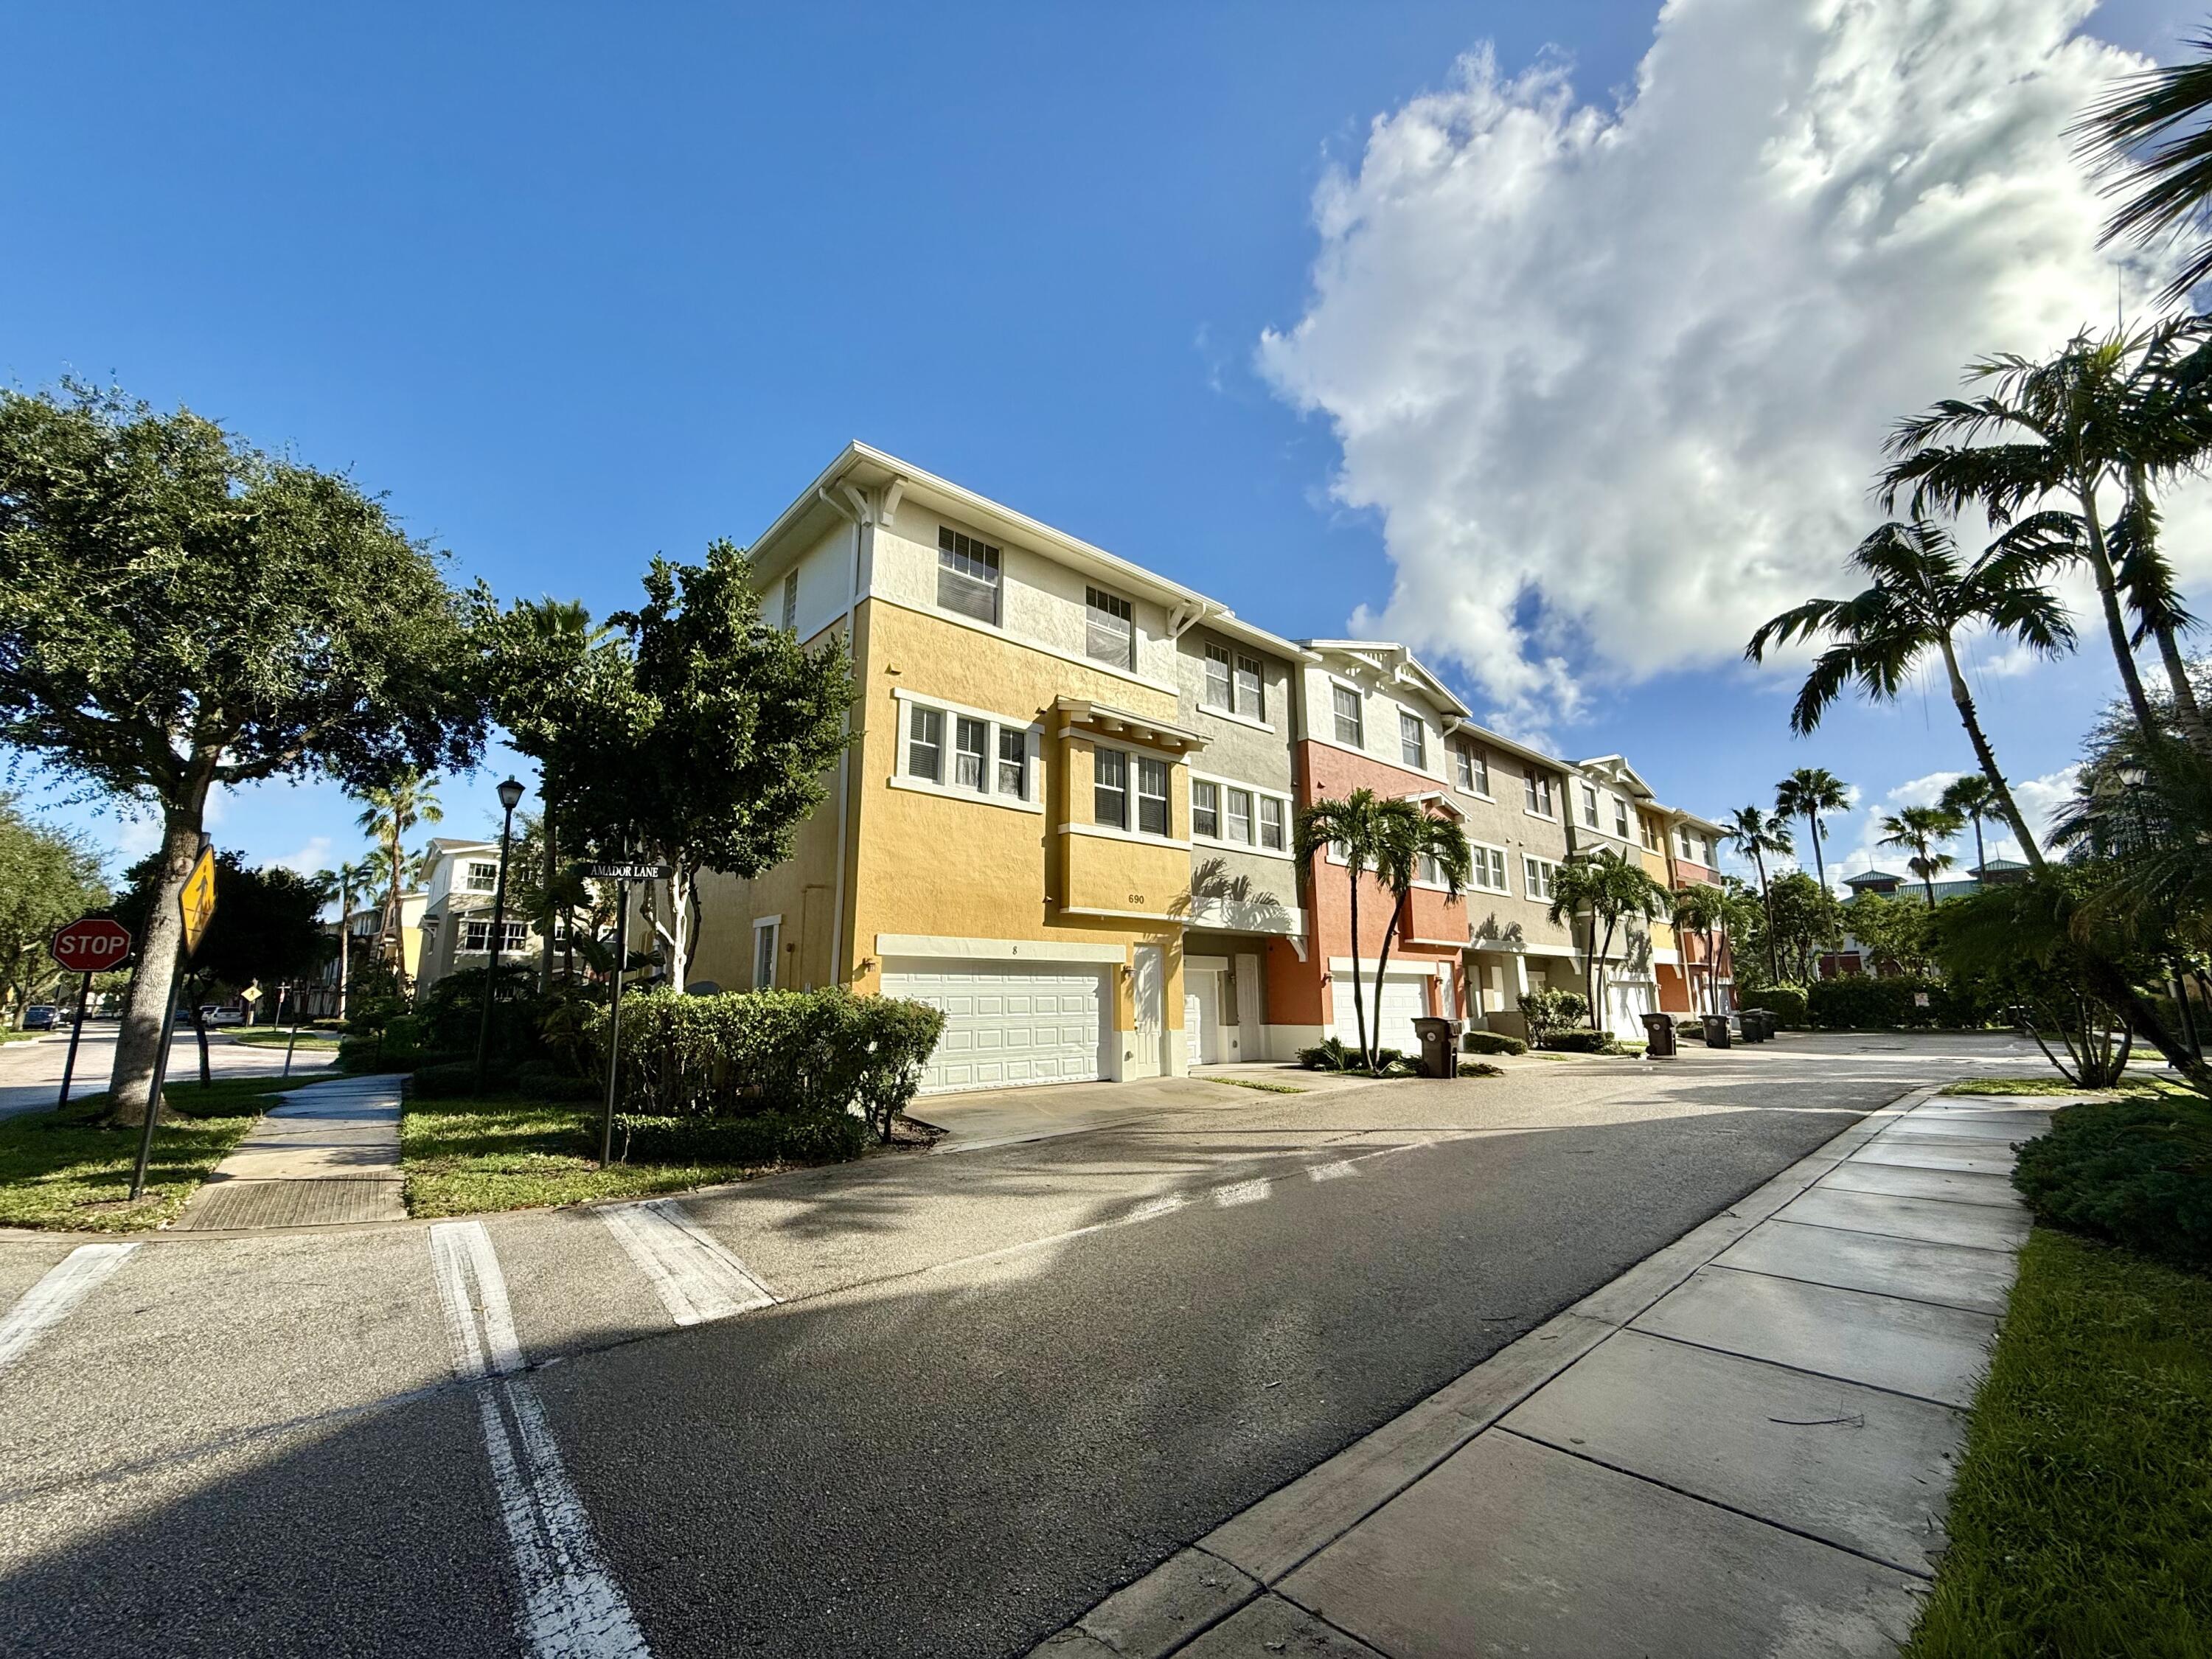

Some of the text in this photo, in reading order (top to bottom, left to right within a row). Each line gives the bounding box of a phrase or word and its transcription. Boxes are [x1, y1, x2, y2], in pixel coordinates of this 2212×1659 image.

[591, 865, 658, 877] AMADOR LANE
[1129, 894, 1144, 904] 690
[59, 936, 125, 954] STOP
[1012, 945, 1018, 955] 8
